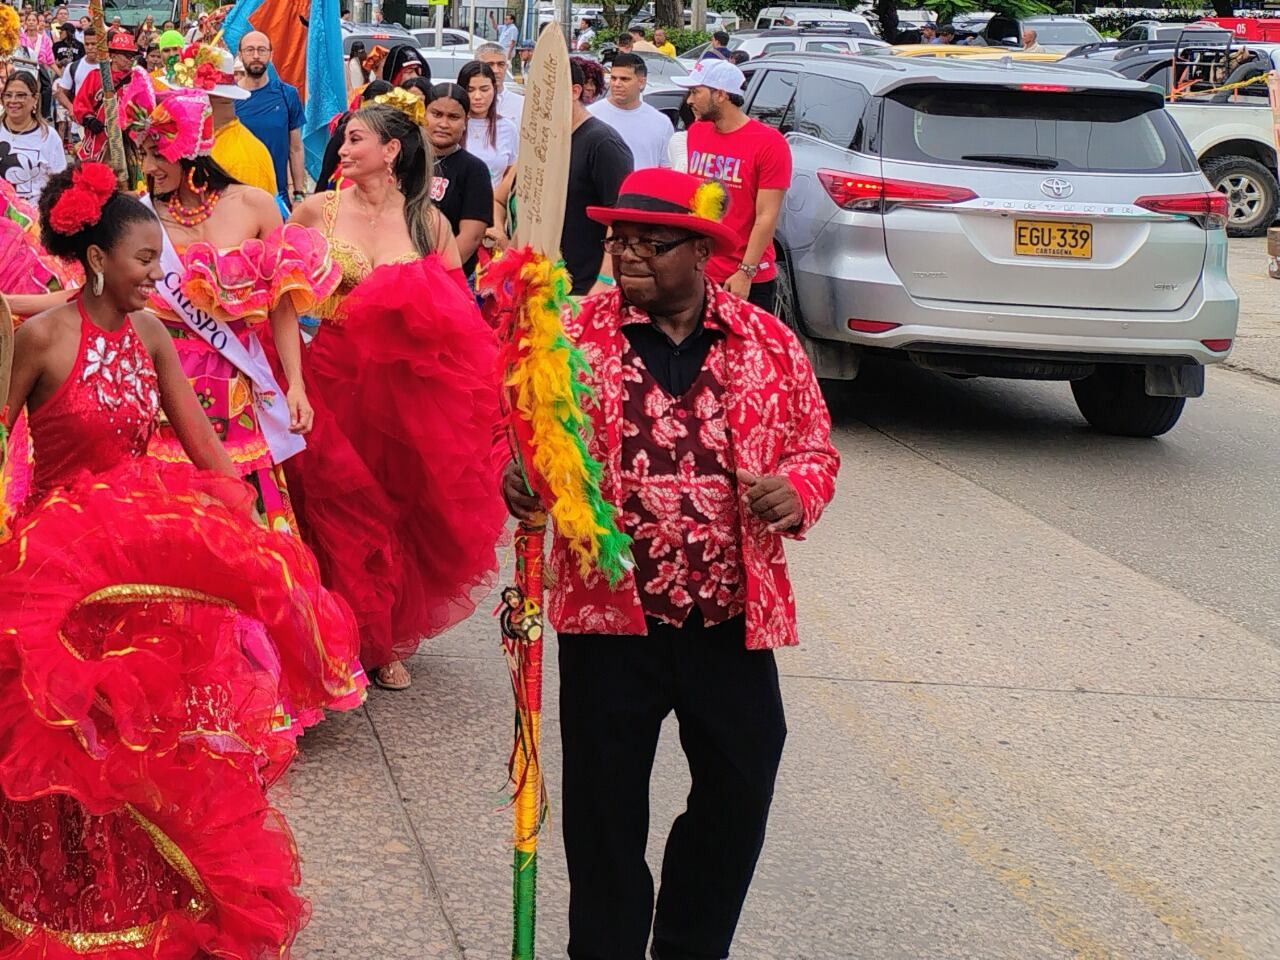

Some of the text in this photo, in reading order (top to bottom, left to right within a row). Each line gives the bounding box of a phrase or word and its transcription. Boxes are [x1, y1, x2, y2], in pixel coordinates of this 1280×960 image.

[1236, 23, 1247, 35] 05
[689, 150, 742, 183] DIESEL
[1017, 226, 1090, 249] EGU 339
[1035, 248, 1073, 256] CARTAGENA
